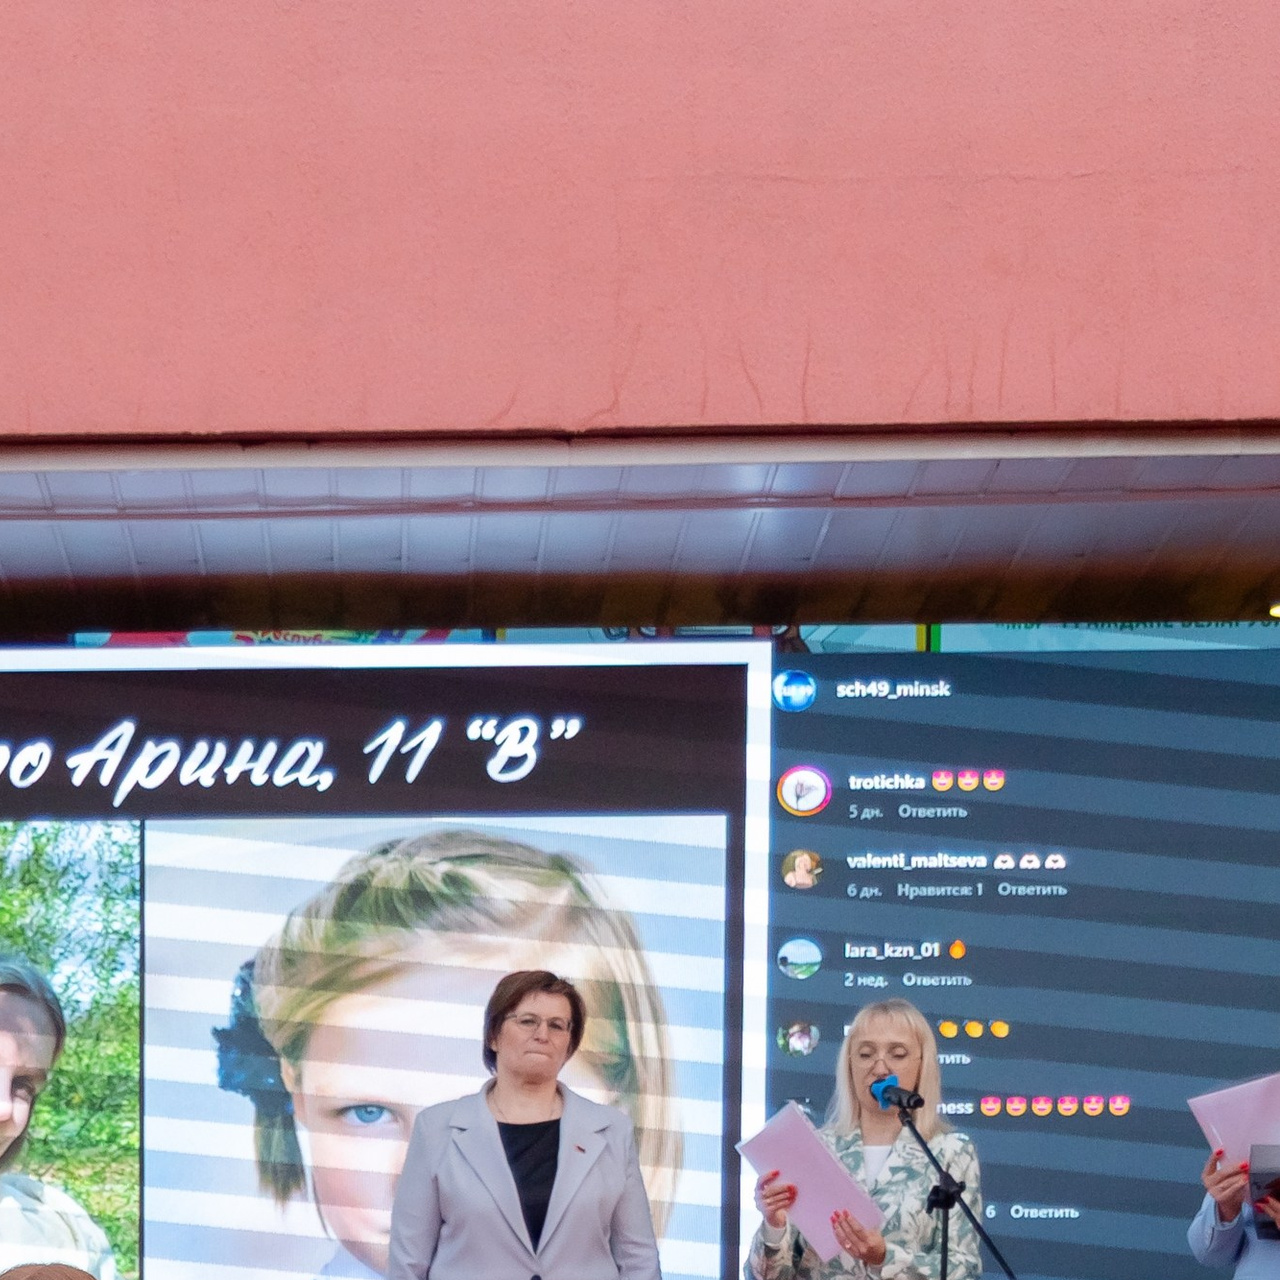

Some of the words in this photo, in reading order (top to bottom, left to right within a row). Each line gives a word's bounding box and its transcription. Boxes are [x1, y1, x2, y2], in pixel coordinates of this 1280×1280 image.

[836, 680, 952, 700] sch49_minsk
[66, 720, 335, 808] Арина,
[363, 718, 443, 785] 11
[848, 773, 926, 790] trotichka
[849, 804, 858, 819] 5
[860, 808, 884, 820] дн.
[898, 804, 969, 819] Ответить
[846, 852, 988, 871] valenti_maltseva
[846, 884, 857, 897] 6
[859, 886, 883, 898] дн.
[897, 883, 972, 900] Нравится:
[998, 883, 1068, 897] Ответить
[844, 942, 941, 961] lara_kzn_01
[844, 973, 854, 987] 2
[857, 975, 889, 988] нед.
[902, 973, 973, 987] Ответить
[986, 1205, 996, 1219] 6
[1010, 1205, 1080, 1219] Ответить
